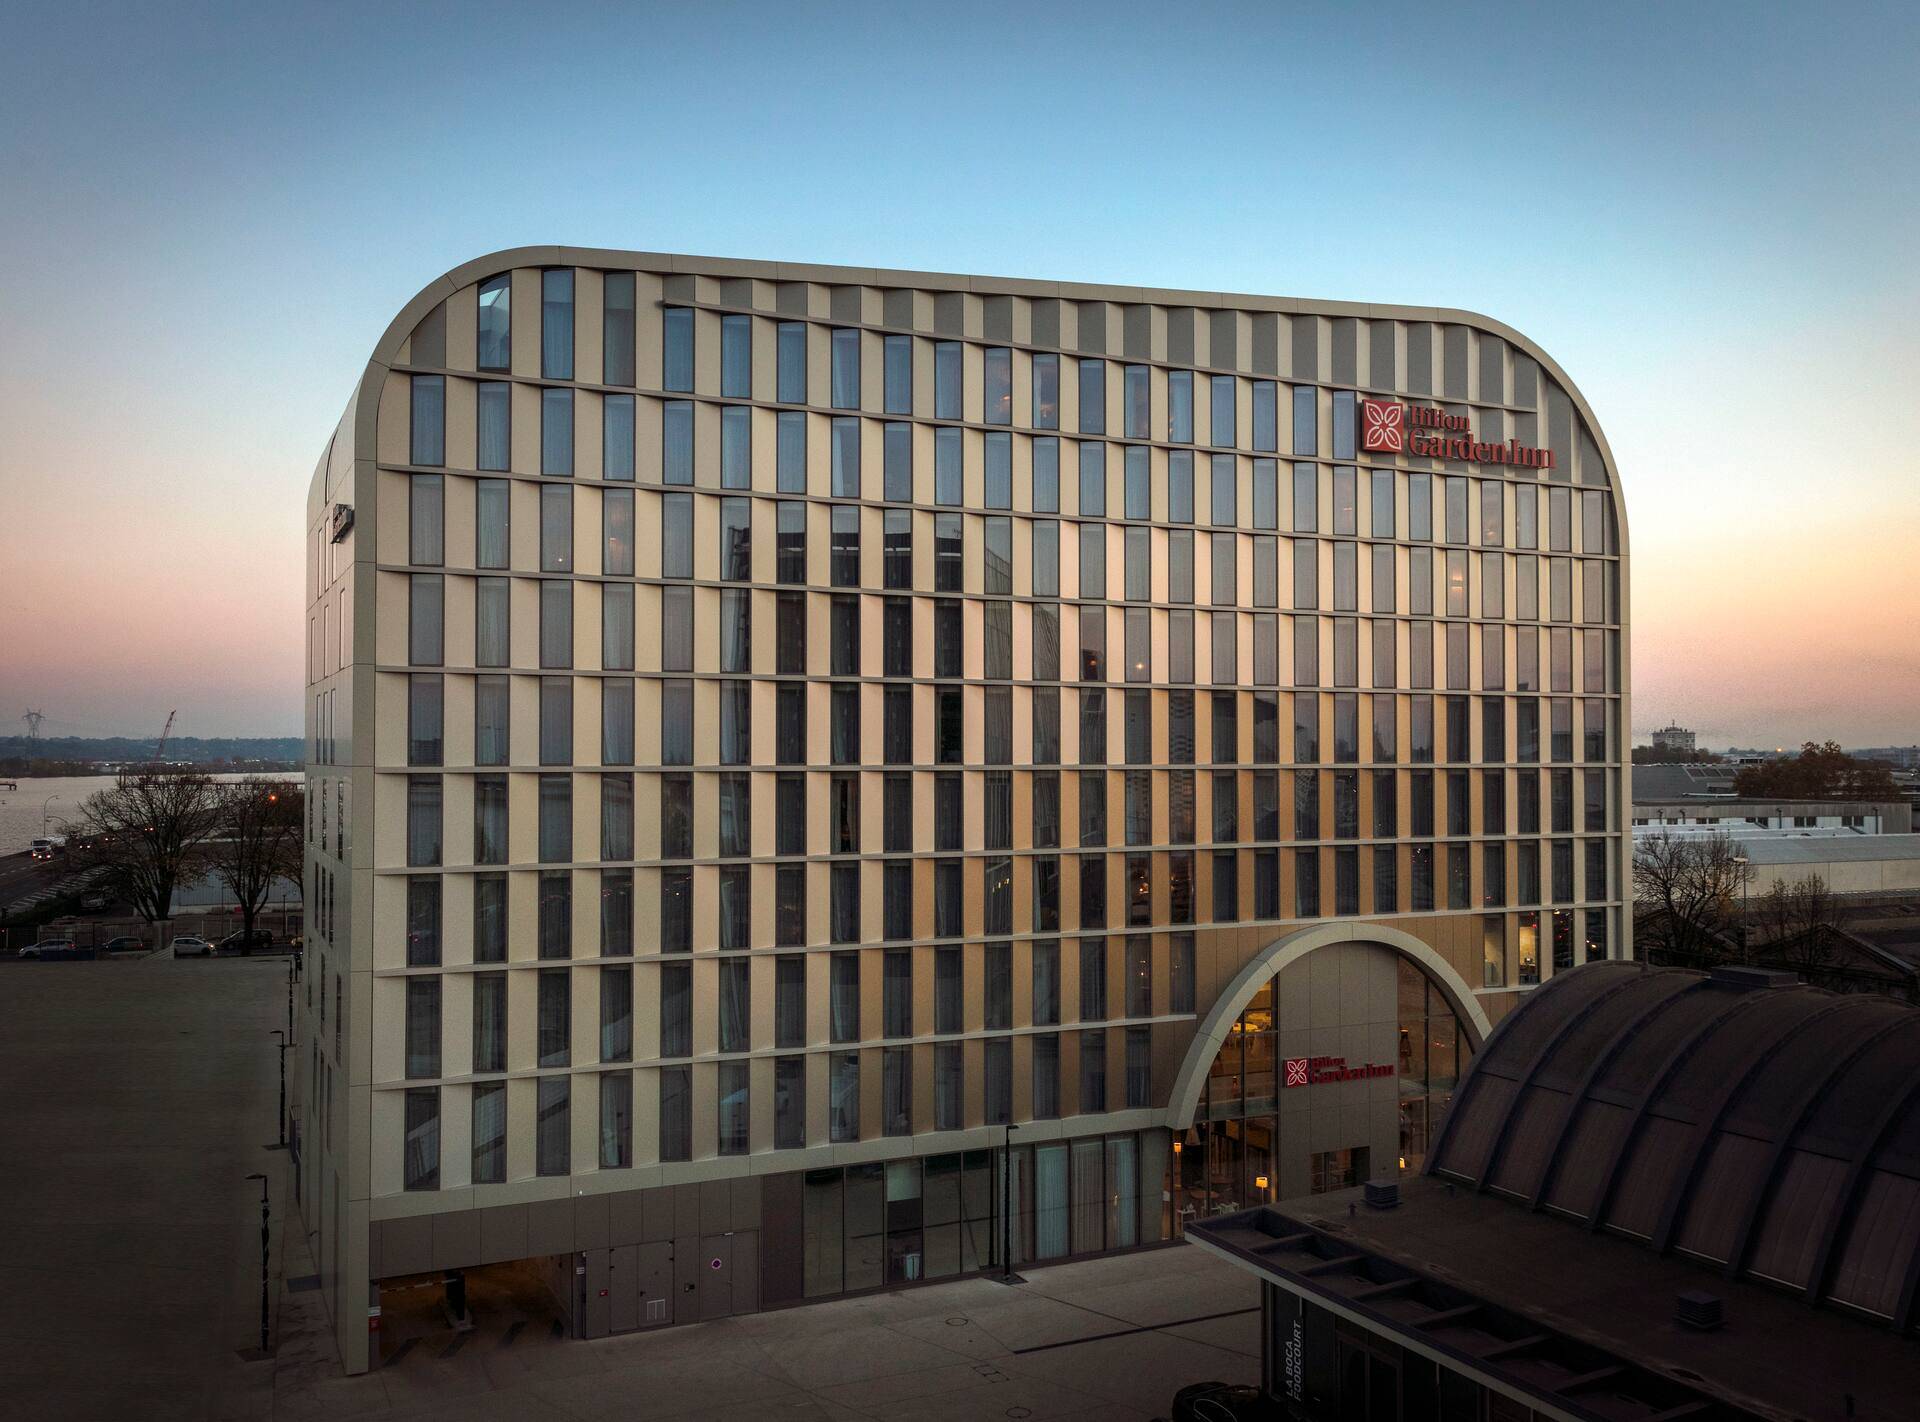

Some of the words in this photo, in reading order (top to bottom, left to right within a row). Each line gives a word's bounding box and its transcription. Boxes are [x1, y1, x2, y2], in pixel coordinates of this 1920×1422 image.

[1409, 405, 1470, 431] Hilton
[1409, 429, 1507, 464] Garden
[1510, 439, 1556, 468] Inn
[1286, 1340, 1294, 1375] BOCA
[1293, 1319, 1302, 1401] FOODCOURT
[1286, 1380, 1294, 1397] LA
